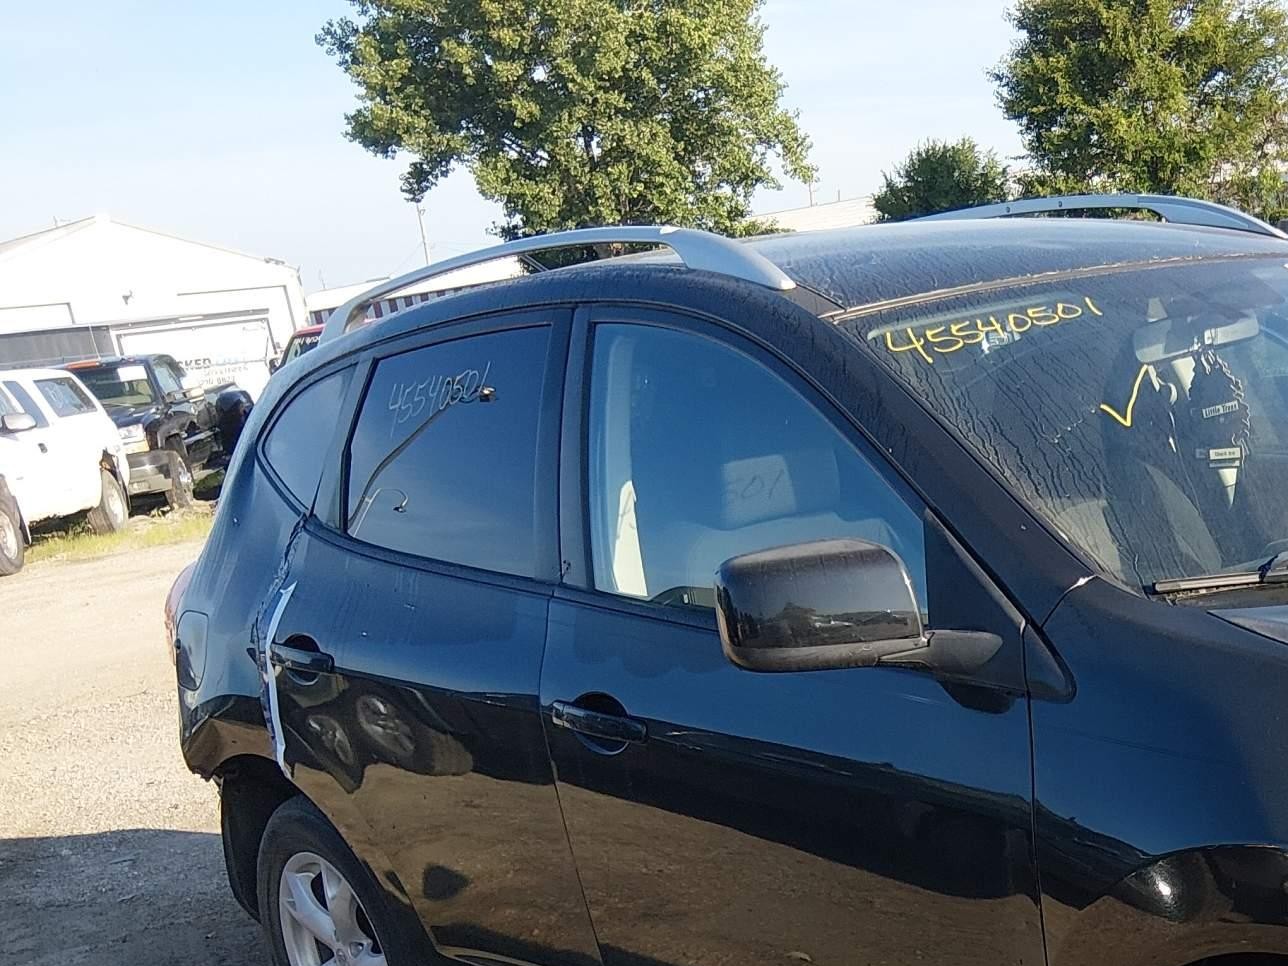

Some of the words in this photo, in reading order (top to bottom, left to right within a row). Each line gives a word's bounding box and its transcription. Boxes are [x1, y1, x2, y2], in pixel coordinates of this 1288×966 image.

[885, 296, 1104, 364] 45540501
[387, 360, 492, 438] 45540501
[1204, 404, 1221, 417] Little
[1222, 401, 1238, 412] Trees
